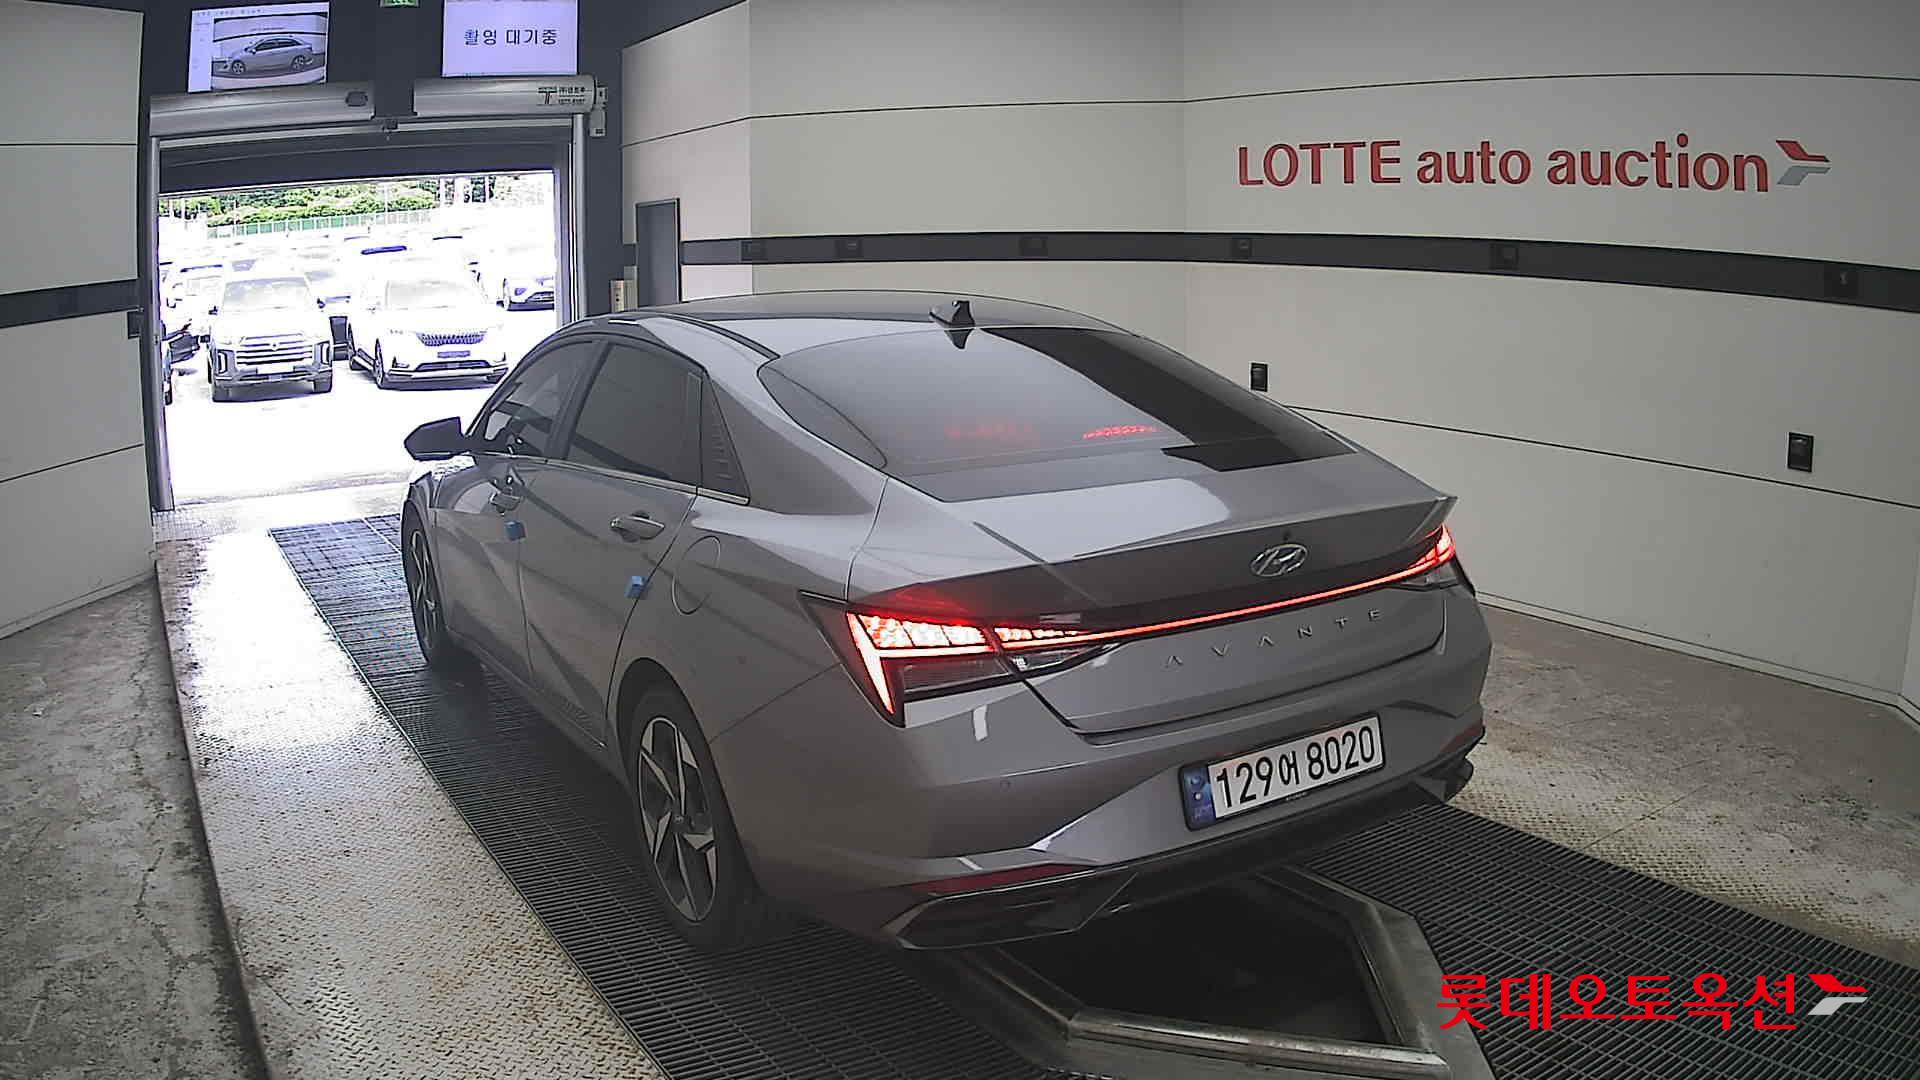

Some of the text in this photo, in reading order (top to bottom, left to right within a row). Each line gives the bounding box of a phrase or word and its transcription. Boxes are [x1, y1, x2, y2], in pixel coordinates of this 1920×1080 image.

[505, 28, 558, 46] 대기중
[1237, 133, 1769, 193] LOTTE auto auction
[1166, 608, 1382, 668] AVANTE
[1306, 725, 1375, 781] 8020
